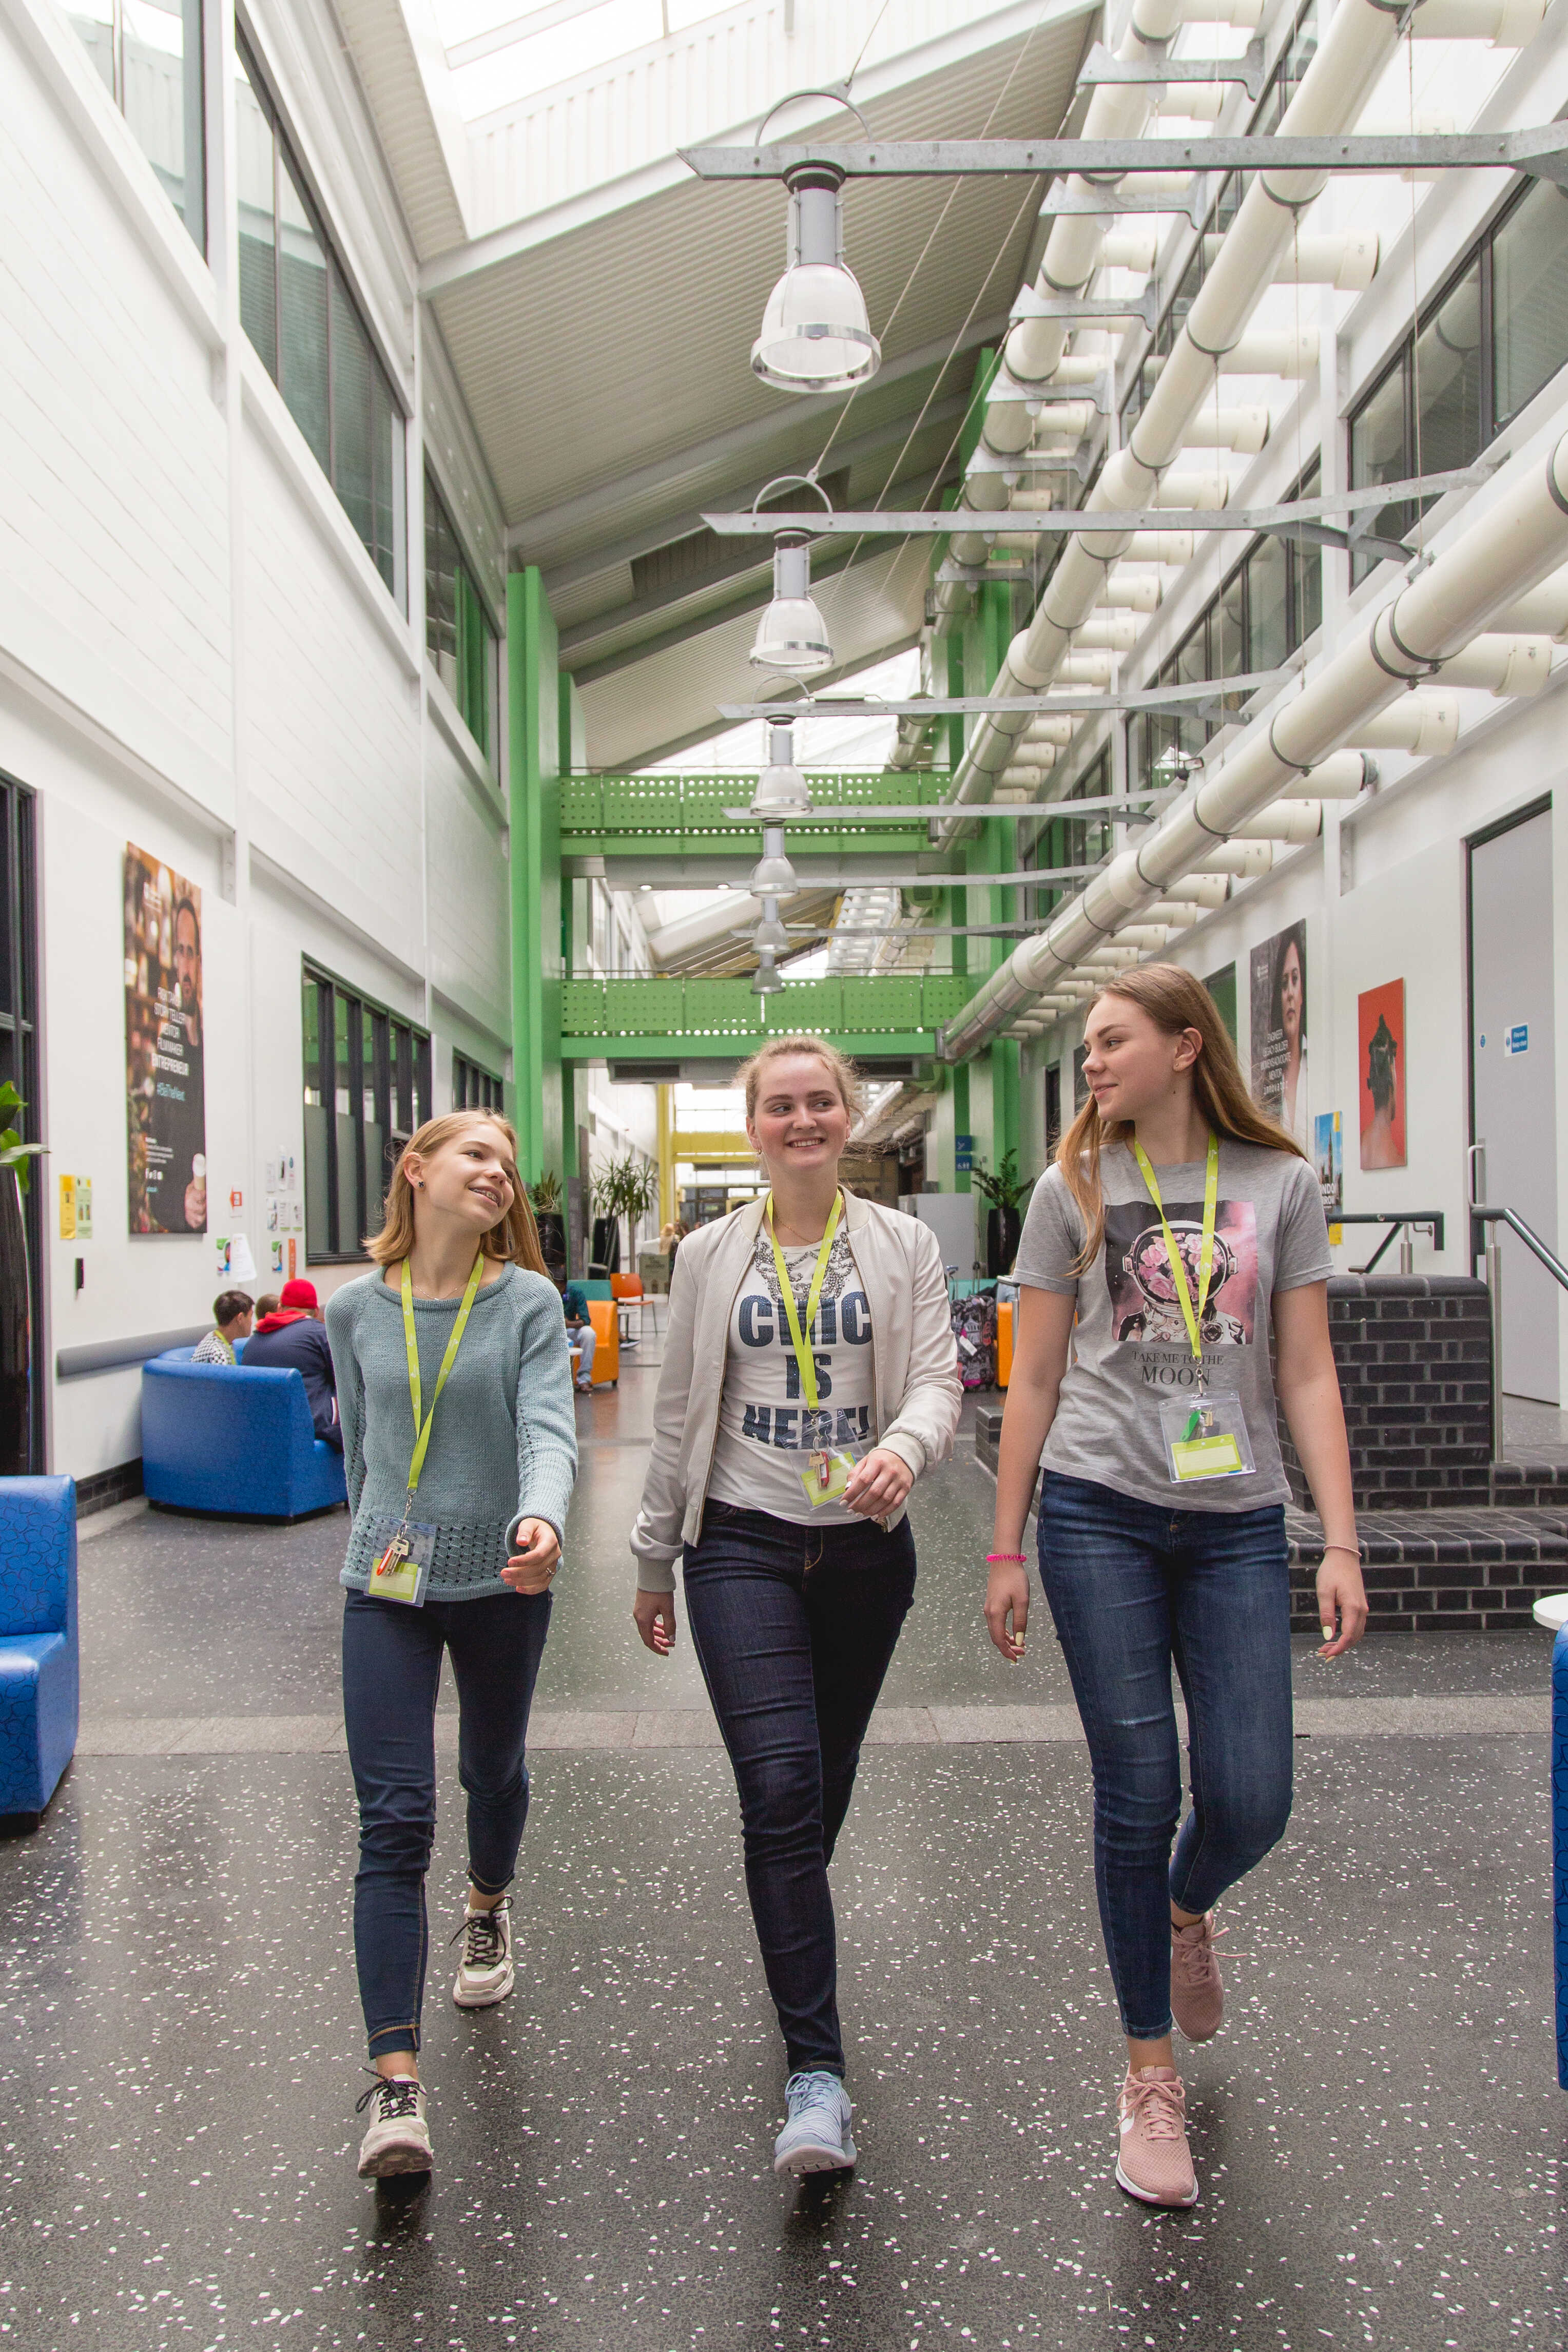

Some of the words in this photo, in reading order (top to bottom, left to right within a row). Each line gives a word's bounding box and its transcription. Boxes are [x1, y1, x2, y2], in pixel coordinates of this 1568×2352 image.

[151, 1052, 189, 1076] ENTREPRENEUR
[1132, 1351, 1159, 1363] TAKE
[1162, 1354, 1179, 1364] ME
[1201, 1355, 1224, 1365] THE
[785, 1353, 832, 1400] IS
[1141, 1365, 1211, 1386] MOON
